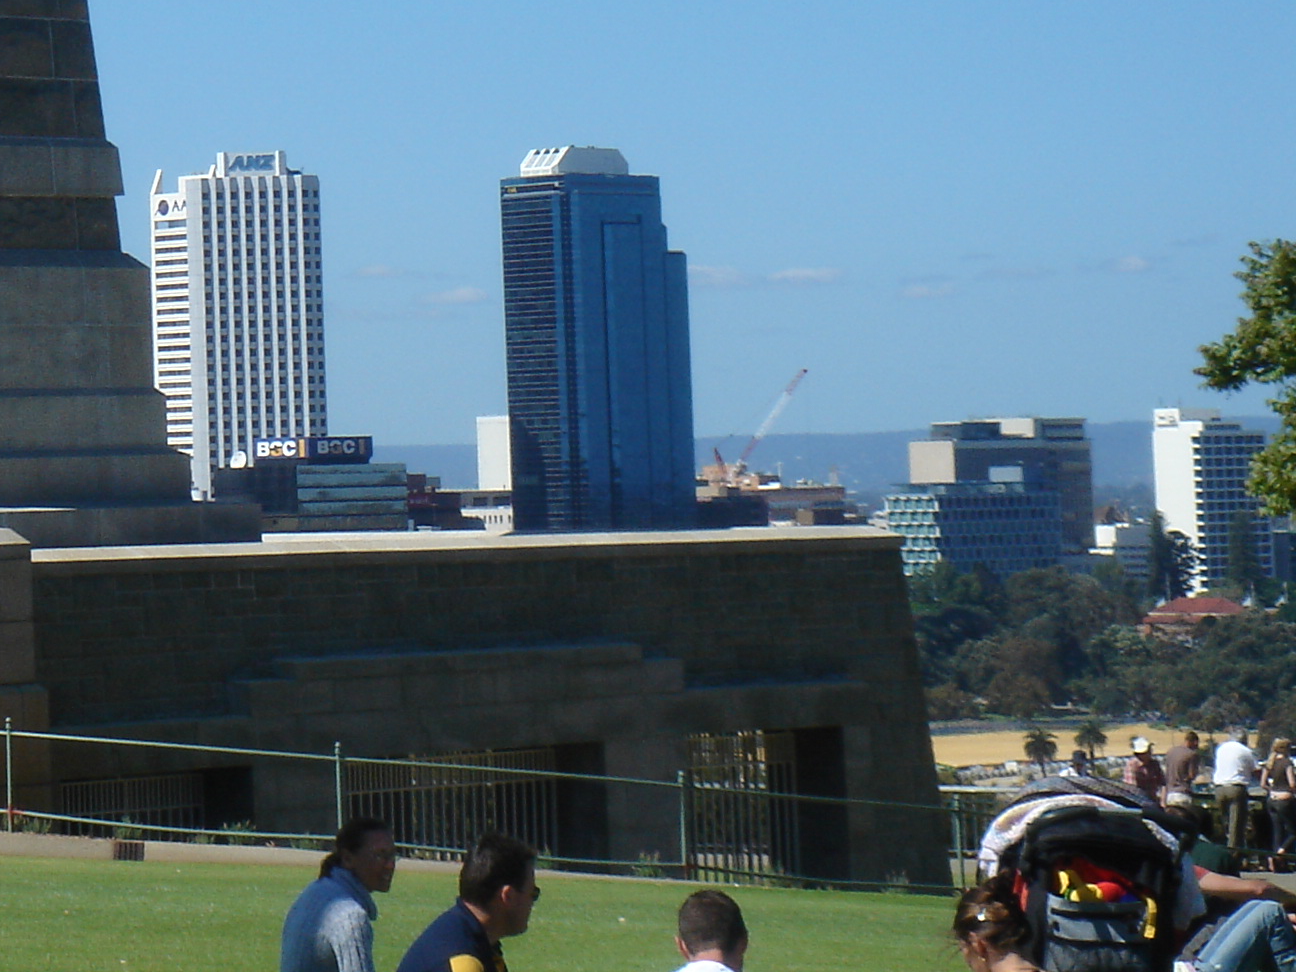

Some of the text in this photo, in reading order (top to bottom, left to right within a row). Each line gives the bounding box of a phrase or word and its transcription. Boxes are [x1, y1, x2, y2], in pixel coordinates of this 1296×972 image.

[228, 155, 275, 171] ANZ
[257, 440, 296, 457] BGC
[317, 440, 355, 454] BGC
